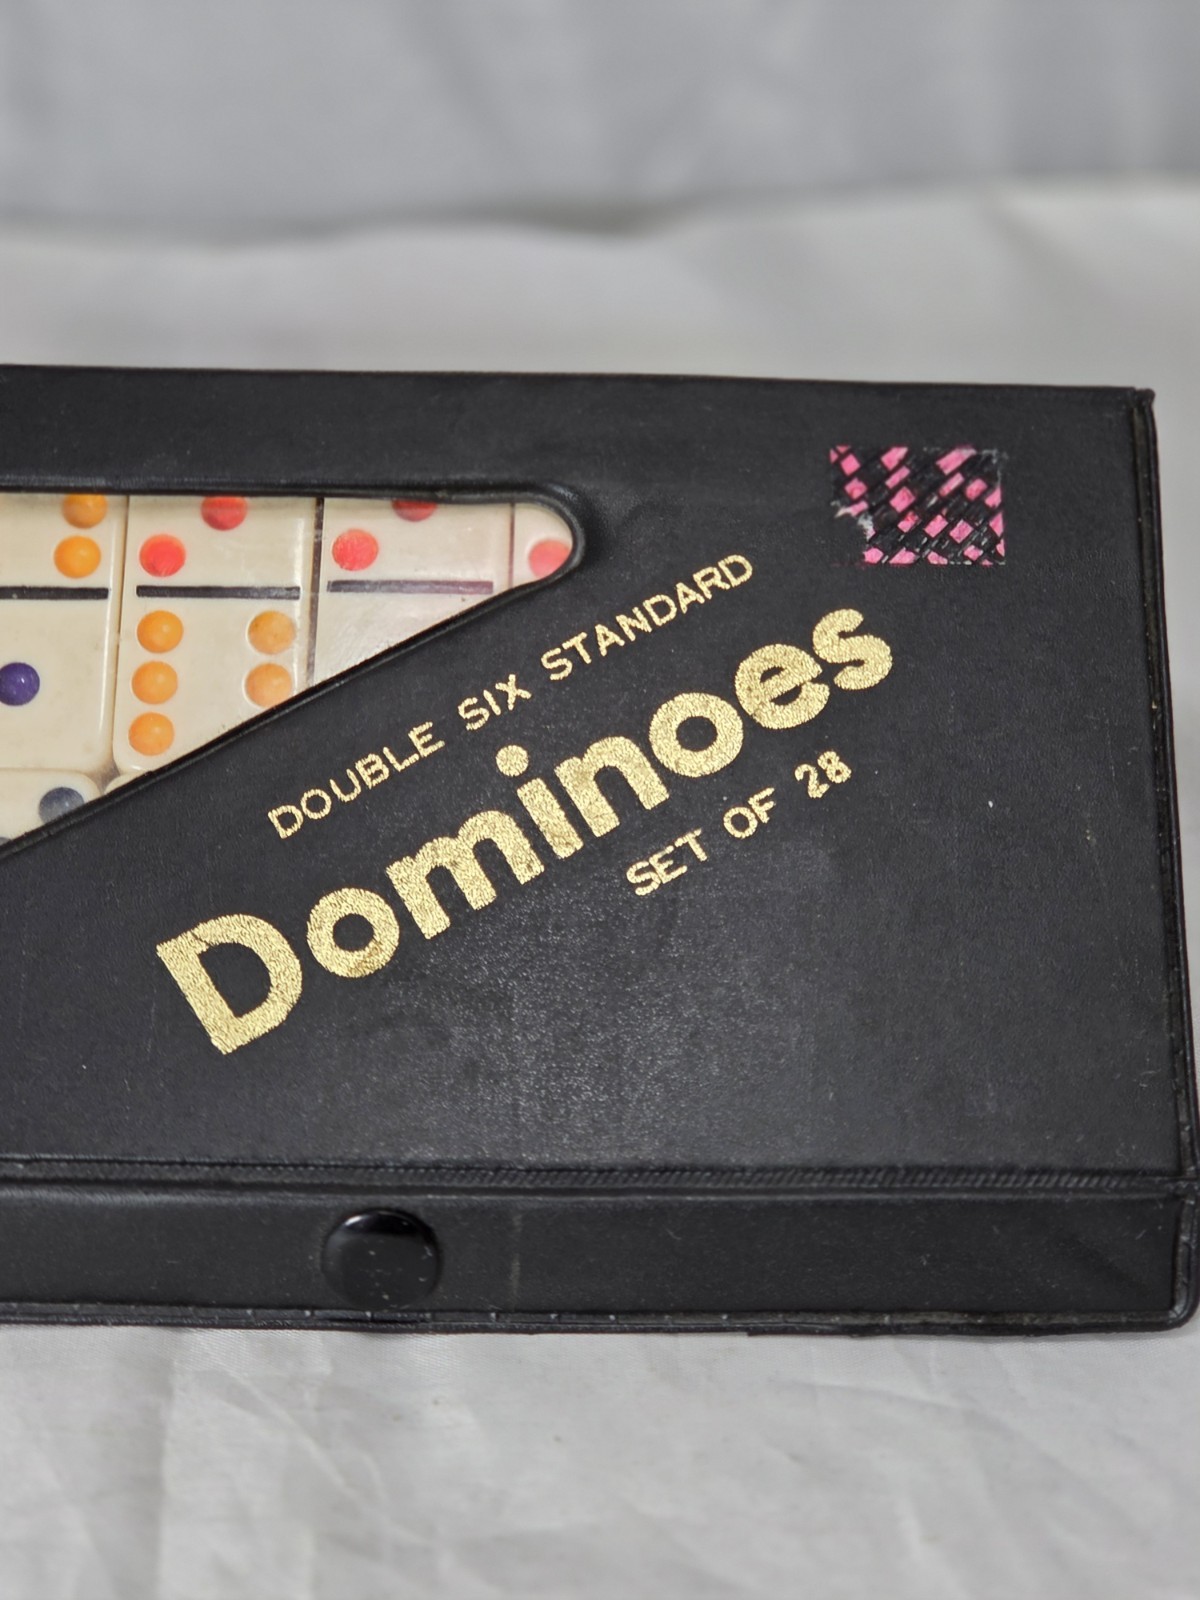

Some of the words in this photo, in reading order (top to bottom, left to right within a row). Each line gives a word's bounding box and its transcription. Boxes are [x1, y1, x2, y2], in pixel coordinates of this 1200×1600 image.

[155, 607, 894, 1056] Dominoes
[267, 721, 445, 840] DOUBLE
[458, 673, 532, 733] SIX
[541, 553, 754, 682] STANDARD
[626, 828, 709, 896] SET
[723, 786, 776, 839] OF
[794, 749, 853, 799] 28
